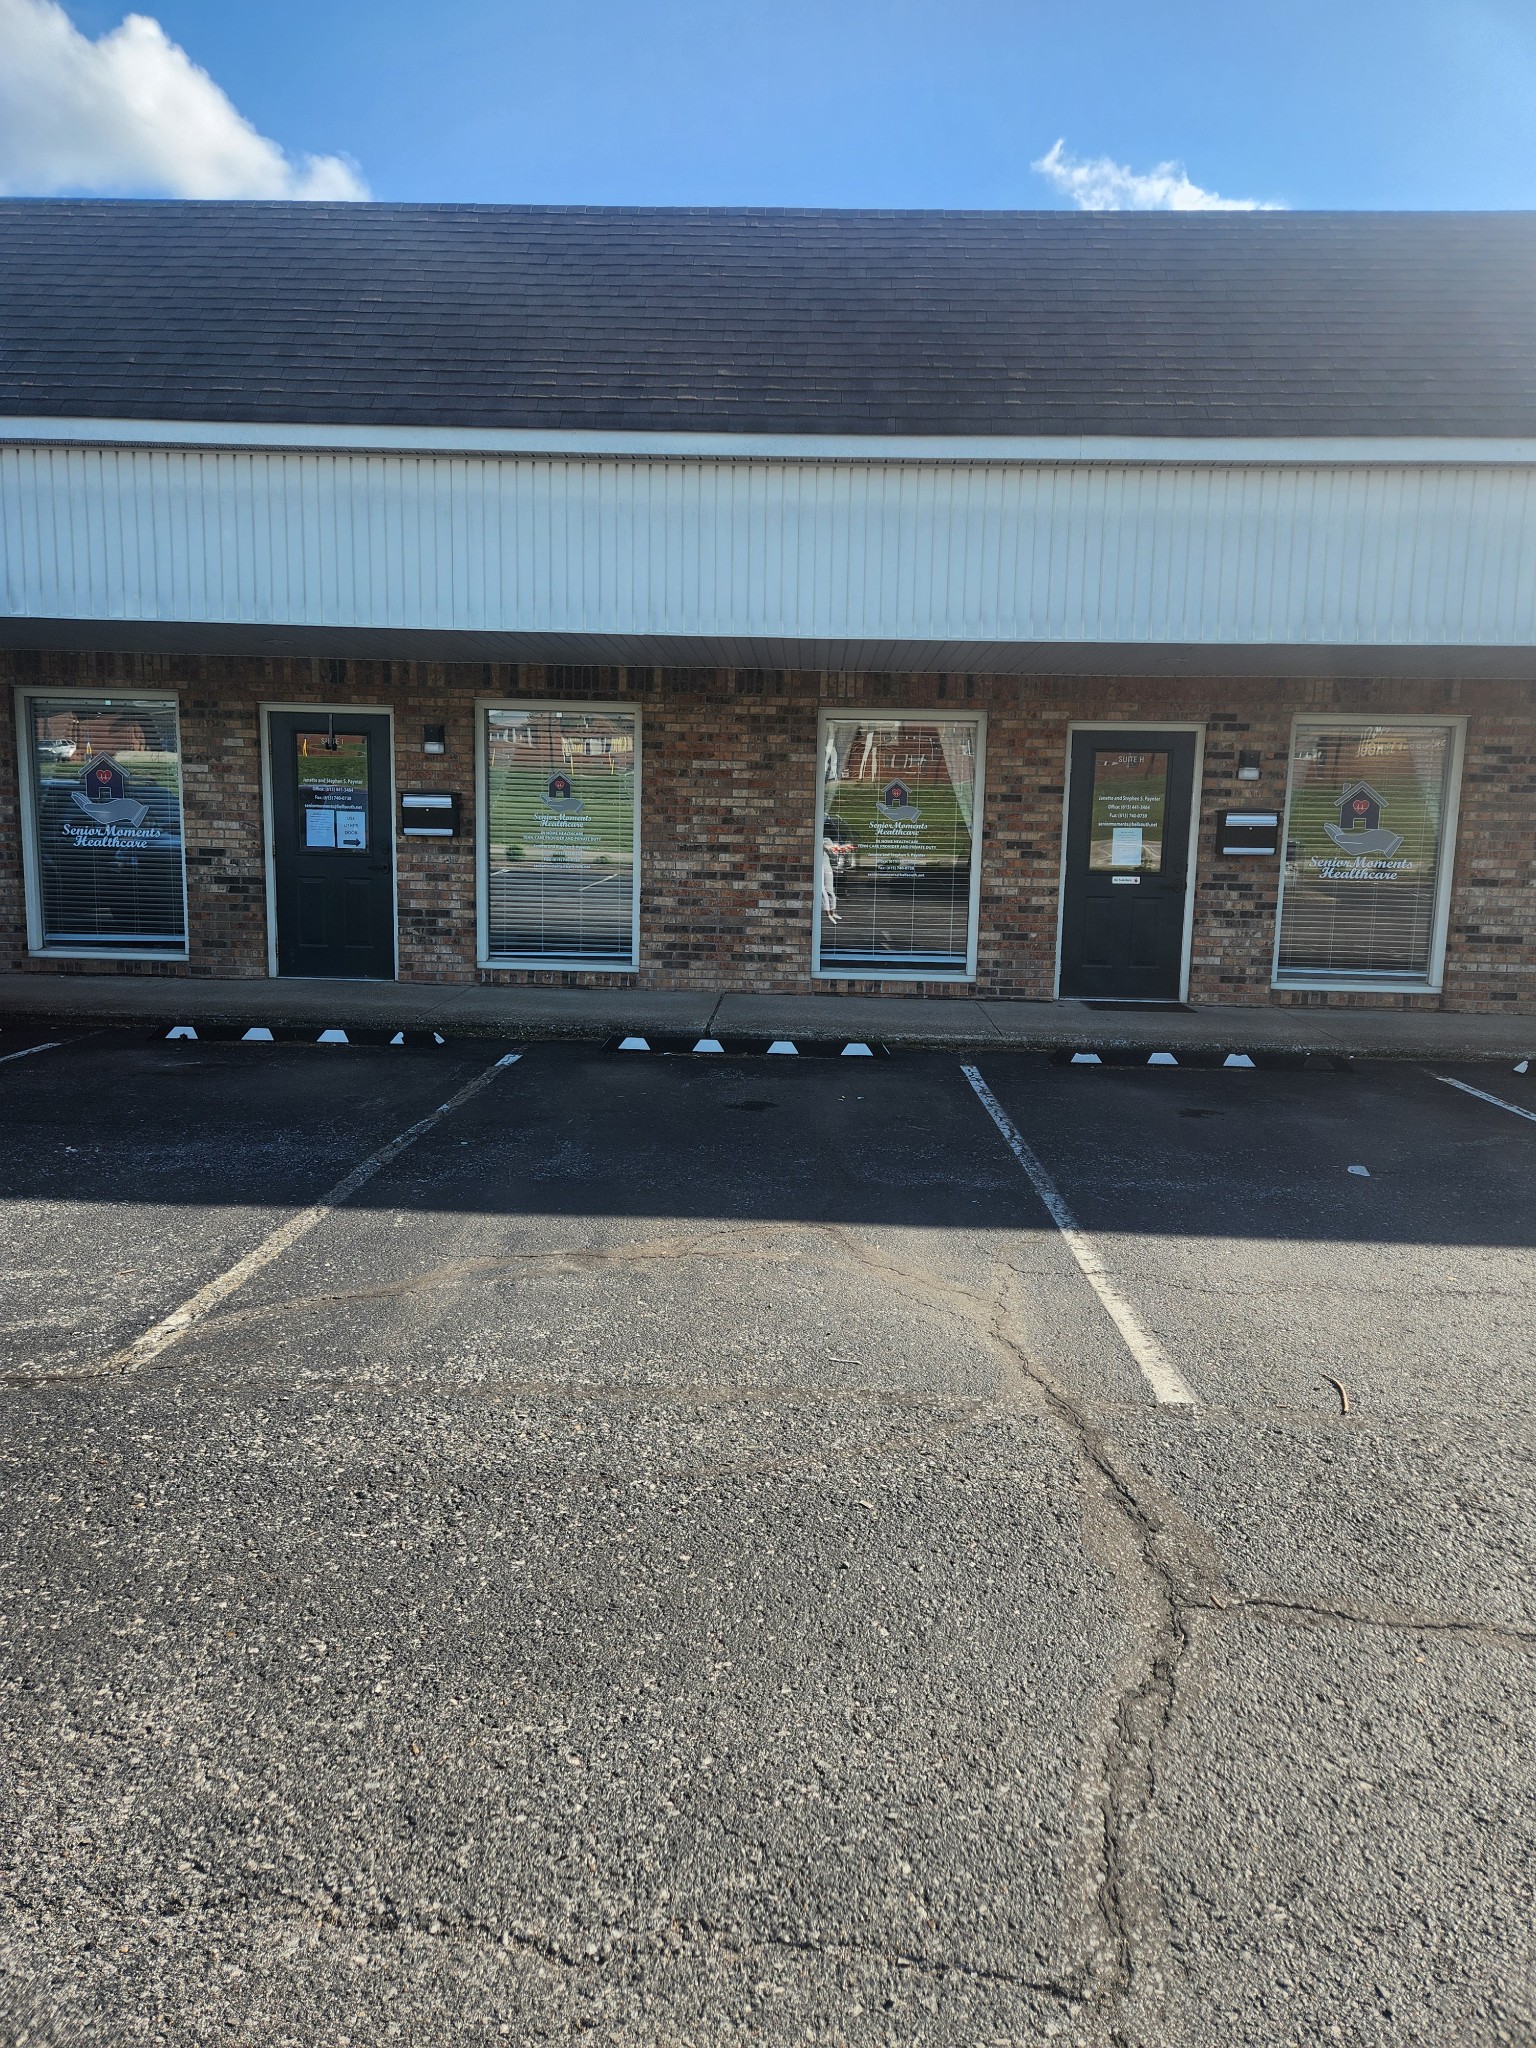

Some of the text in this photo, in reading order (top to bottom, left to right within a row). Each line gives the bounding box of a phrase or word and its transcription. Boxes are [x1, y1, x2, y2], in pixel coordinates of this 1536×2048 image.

[62, 824, 161, 838] Senior Moments
[73, 836, 148, 848] Healthcare
[1309, 856, 1412, 868] Senior Moments
[1319, 867, 1398, 880] Healthcare
